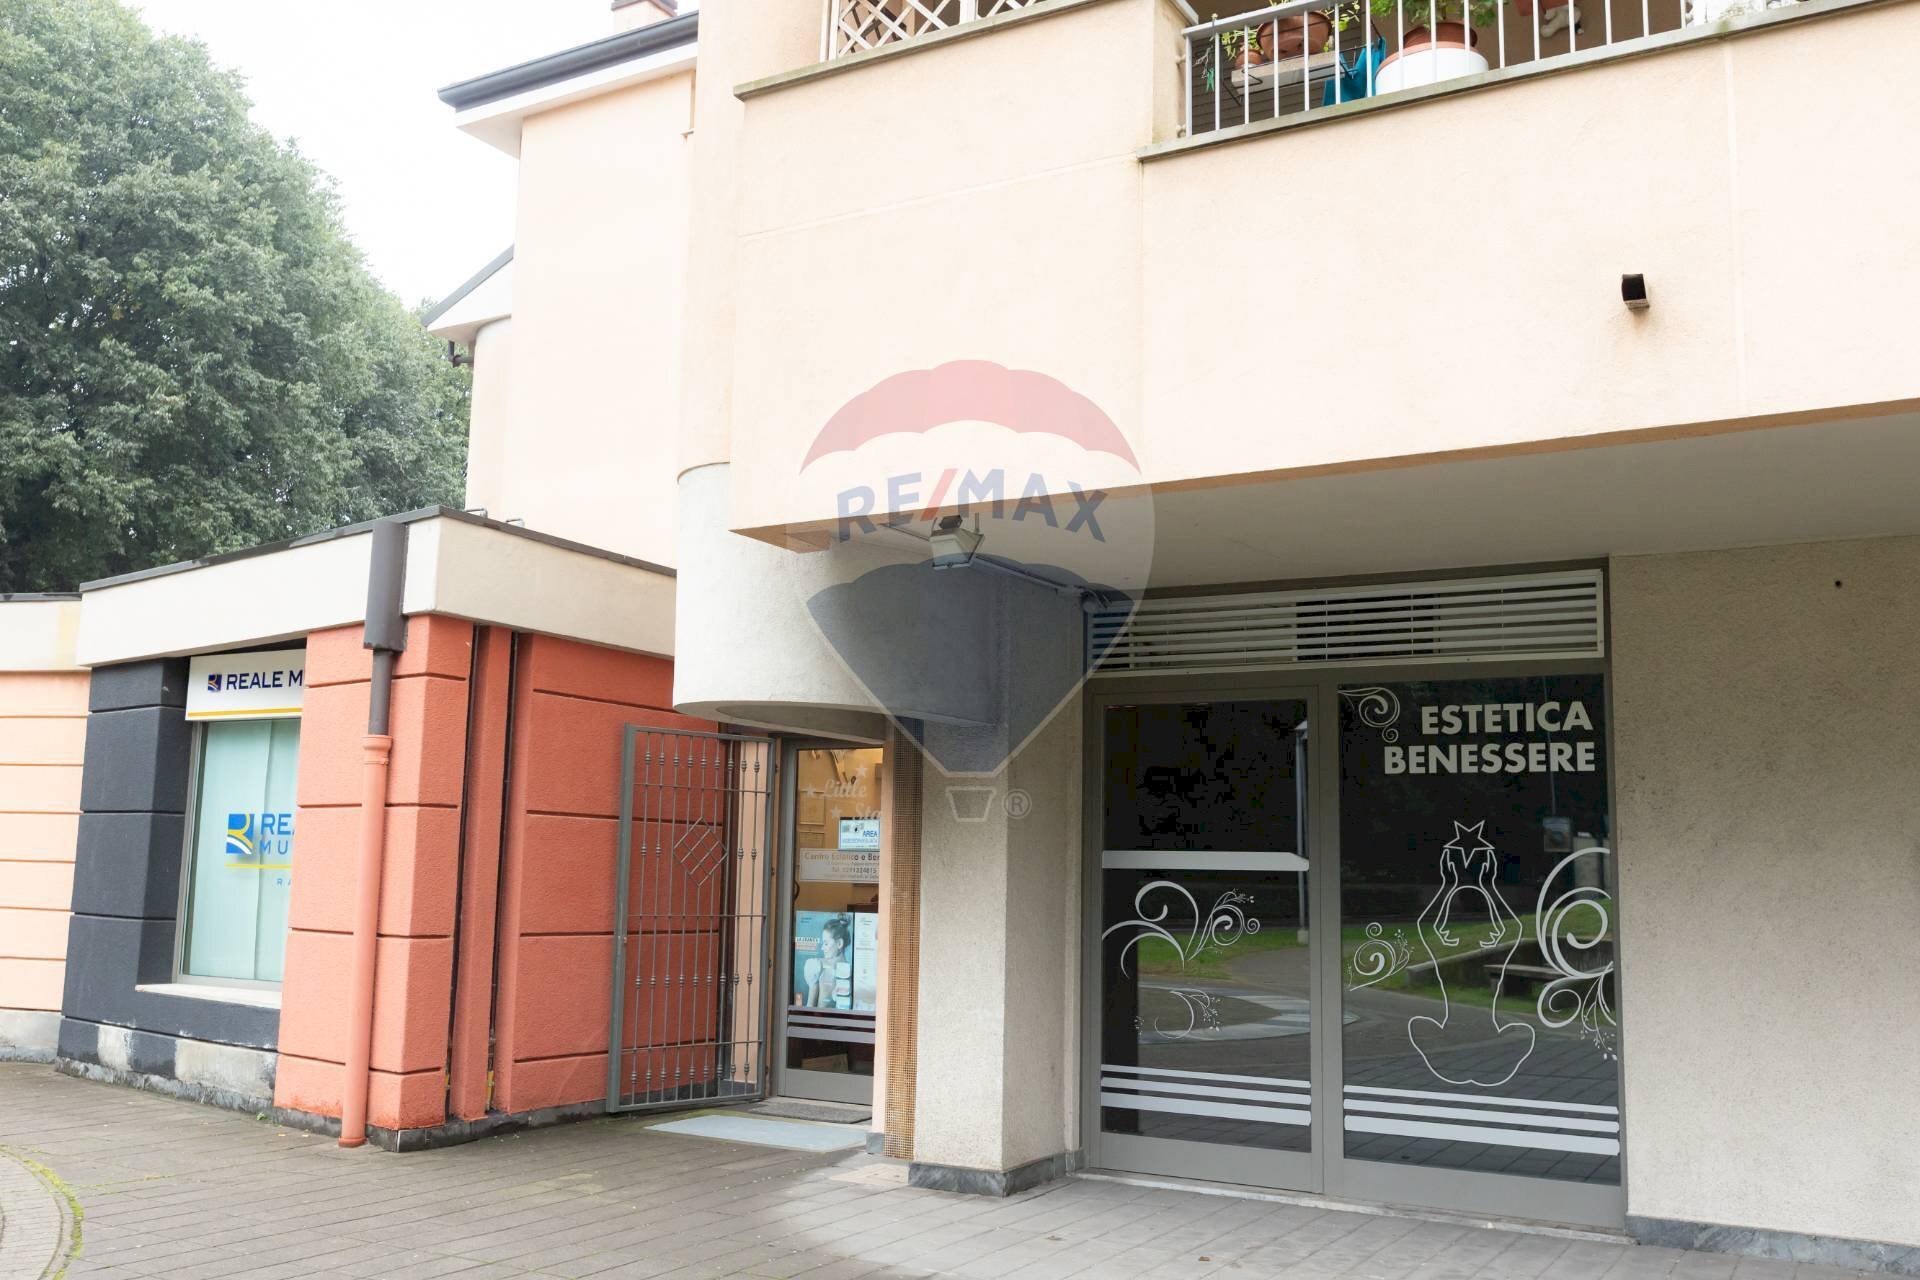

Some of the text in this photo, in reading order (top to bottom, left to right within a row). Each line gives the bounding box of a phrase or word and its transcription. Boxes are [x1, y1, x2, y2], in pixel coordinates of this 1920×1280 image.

[226, 671, 284, 690] REALE
[1421, 701, 1593, 735] ESTETICA
[1384, 741, 1596, 775] BENESSERE
[817, 778, 866, 800] Little
[260, 813, 295, 836] RE
[863, 830, 878, 838] AREA
